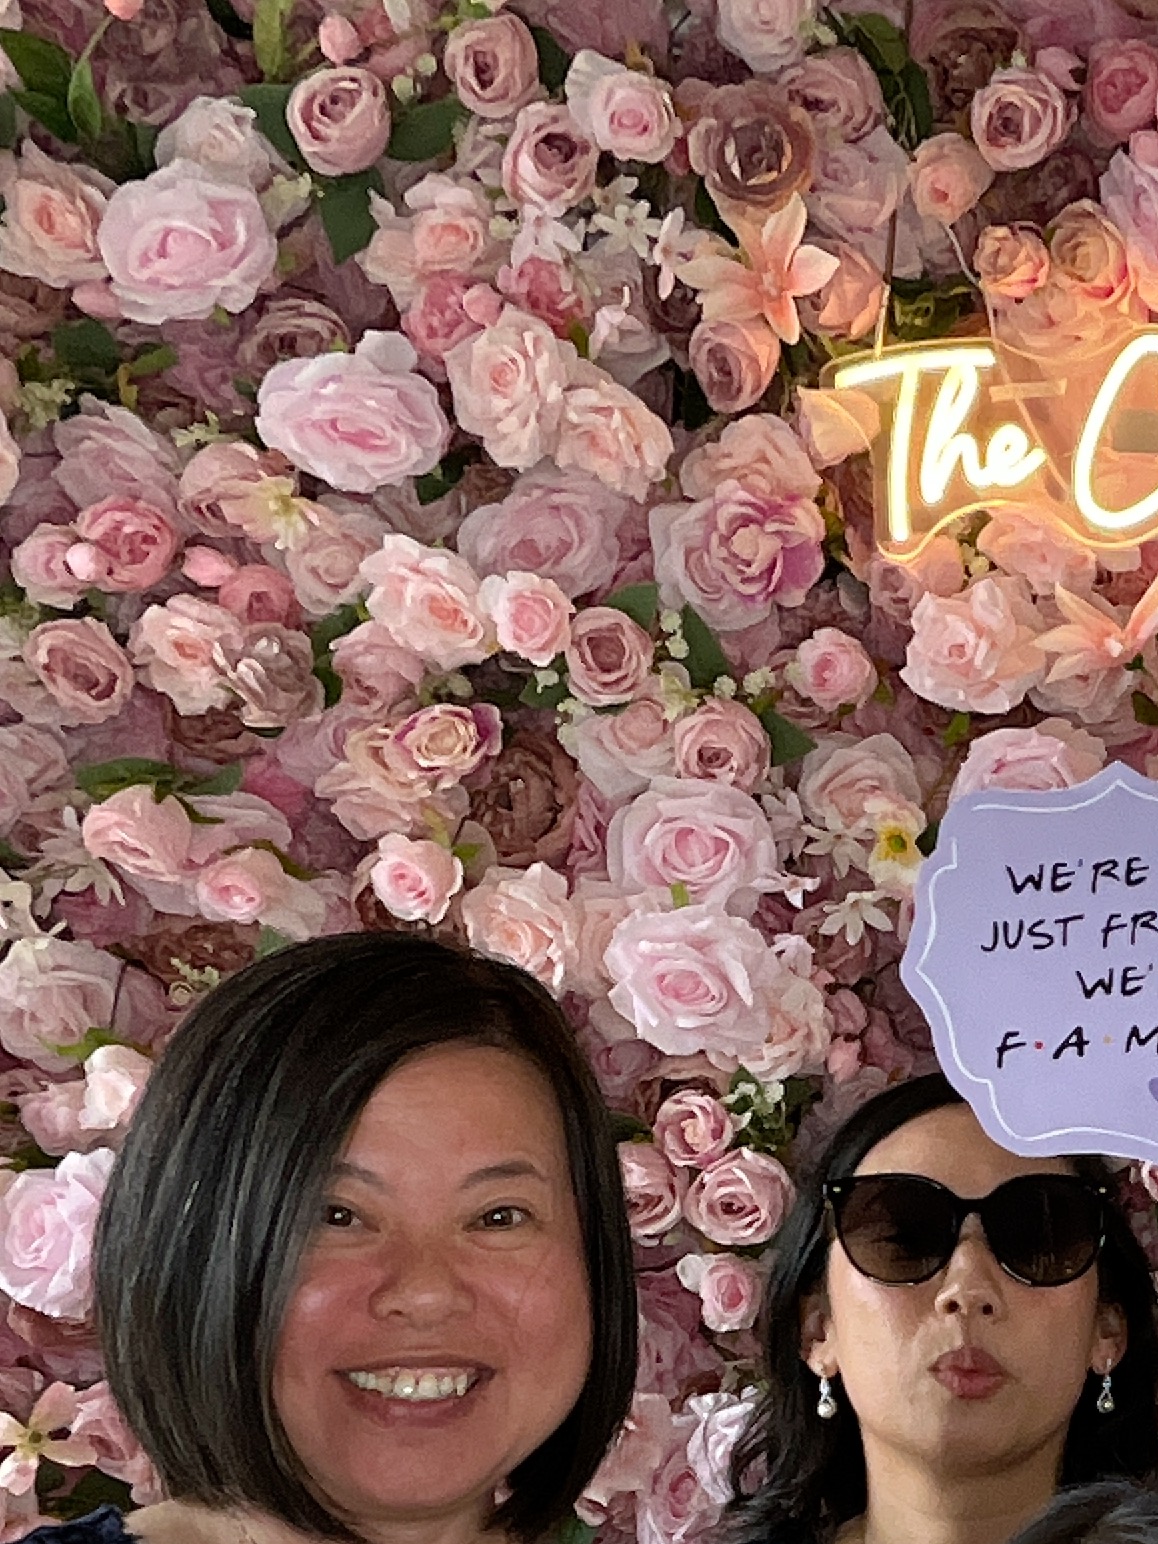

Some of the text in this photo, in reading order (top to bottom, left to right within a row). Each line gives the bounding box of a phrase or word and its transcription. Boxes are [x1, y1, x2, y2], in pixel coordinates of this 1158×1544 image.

[834, 348, 1046, 542] The
[1005, 856, 1150, 895] WE'RE
[980, 914, 1085, 952] JUST
